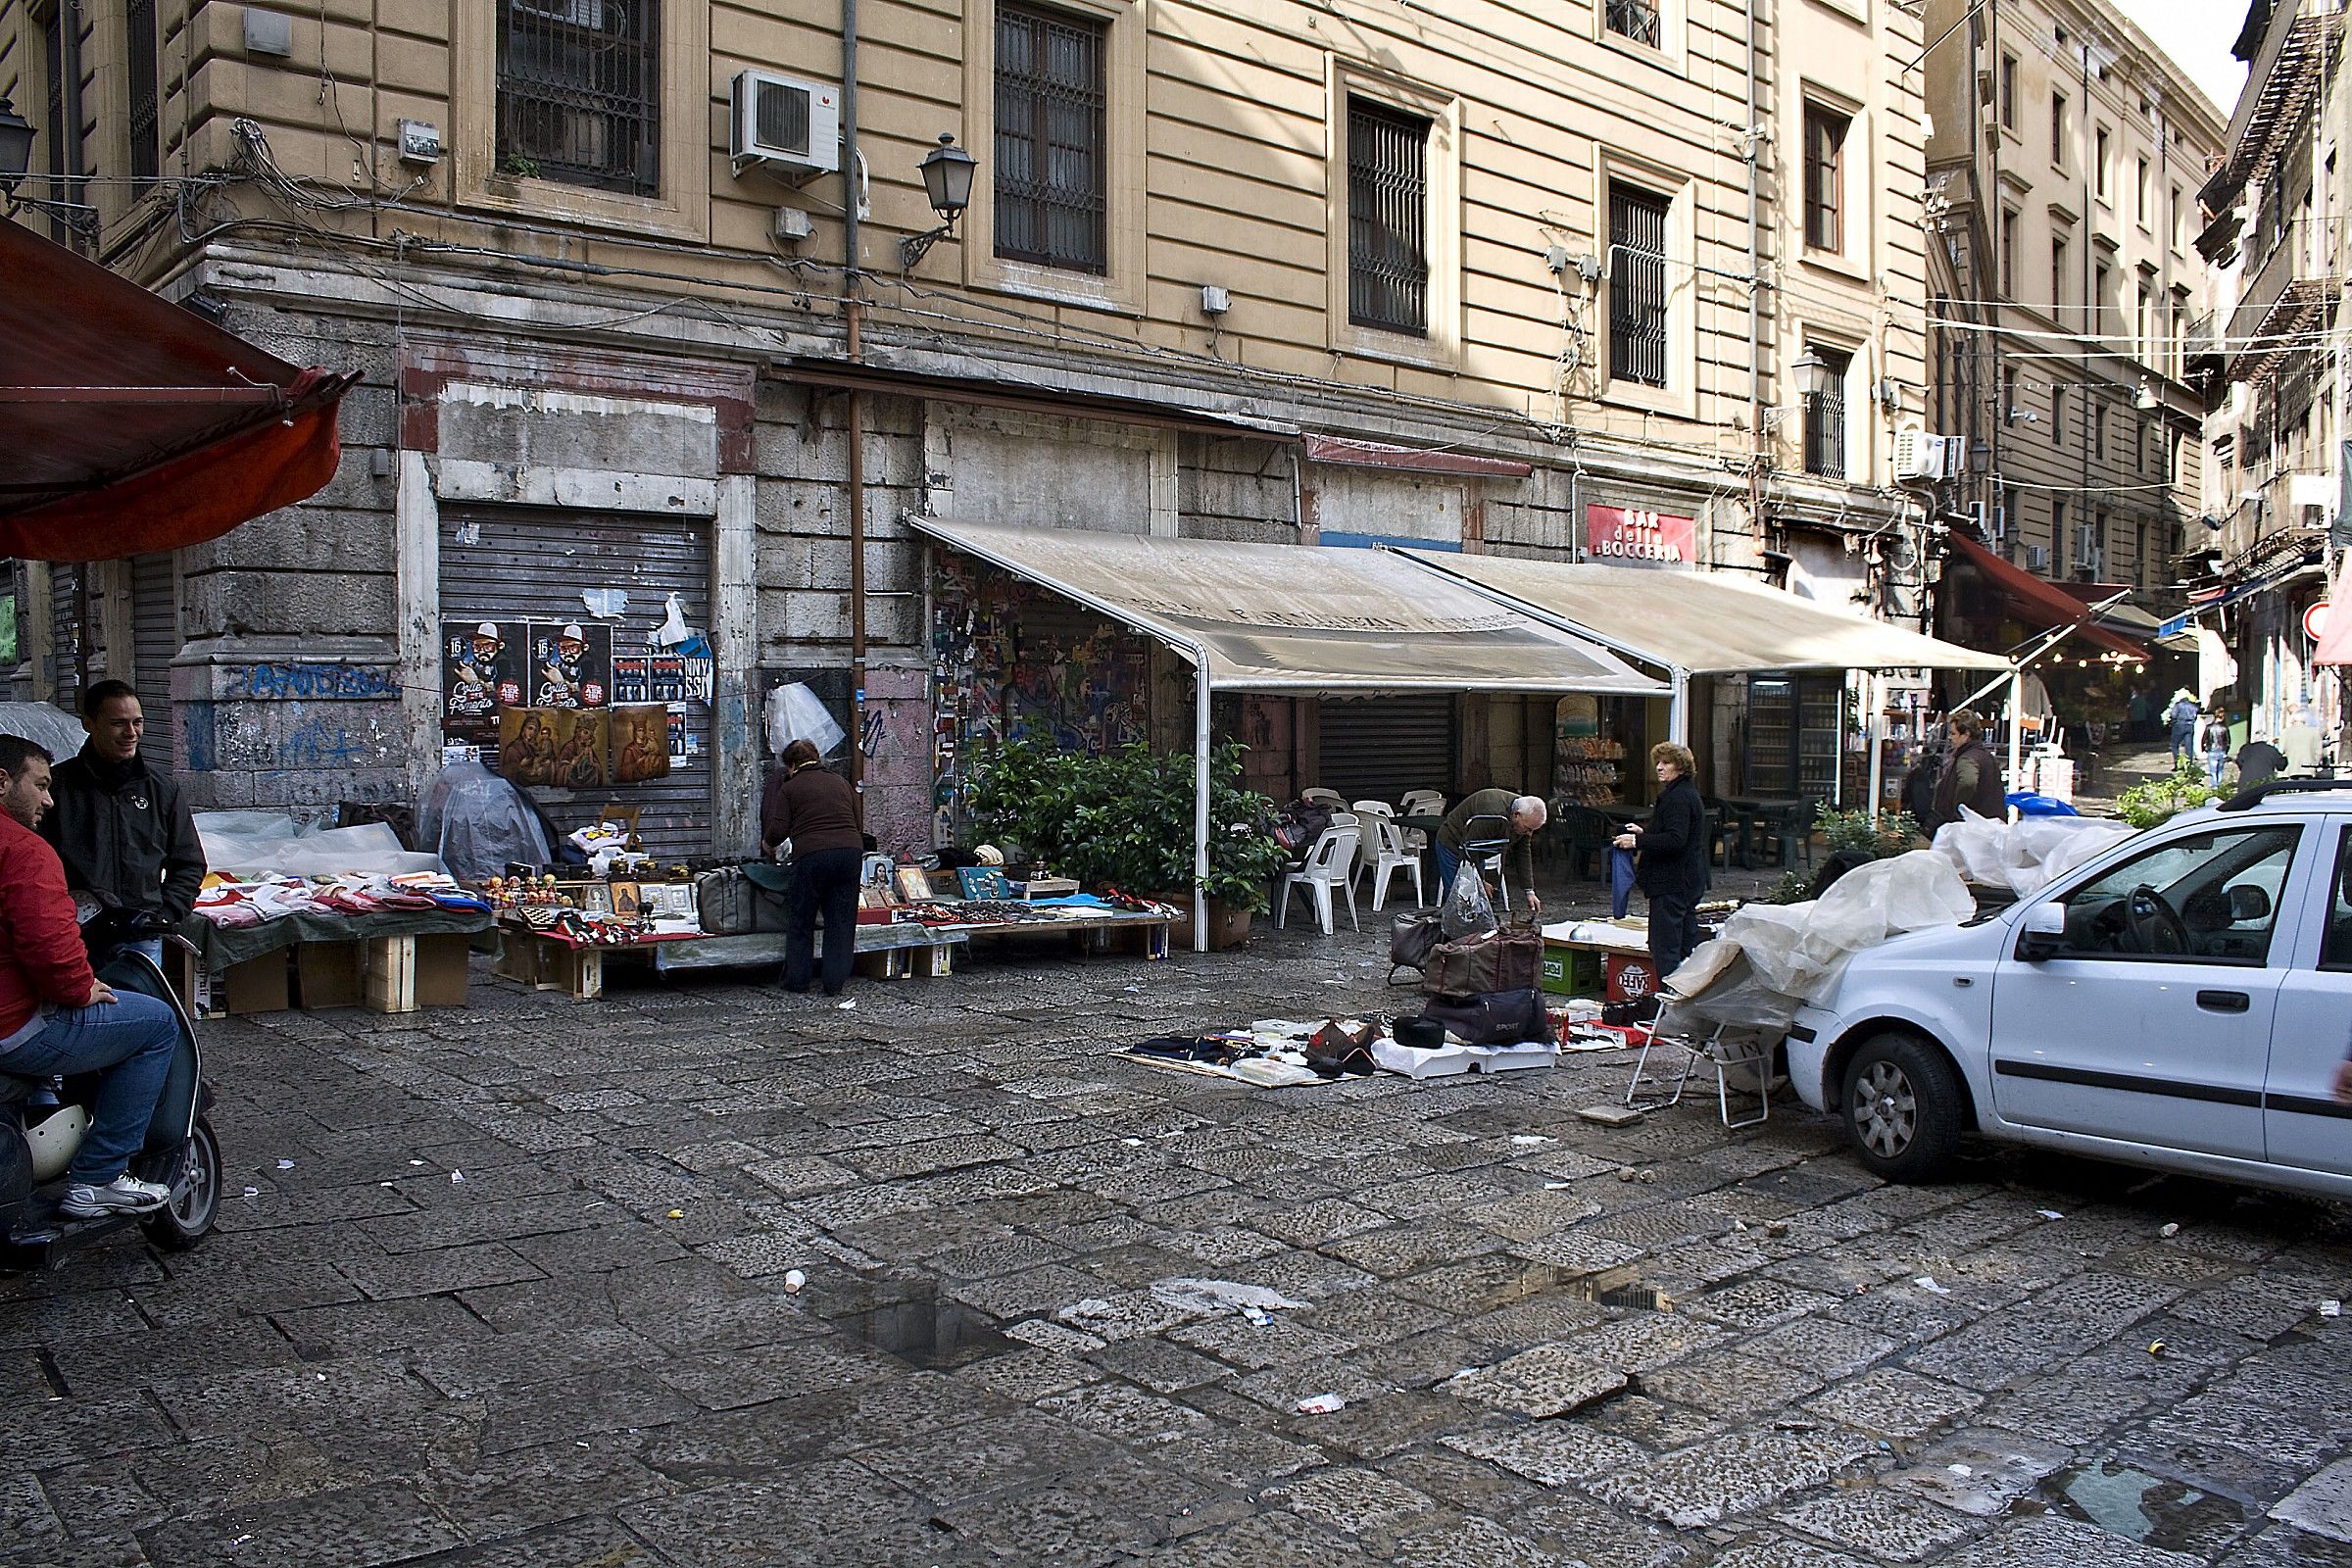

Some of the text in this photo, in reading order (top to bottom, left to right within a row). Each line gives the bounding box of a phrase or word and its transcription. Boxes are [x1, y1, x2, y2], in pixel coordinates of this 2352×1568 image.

[1624, 509, 1659, 529] BAR
[1614, 524, 1663, 545] della
[1600, 539, 1683, 562] BOCCERIA
[450, 640, 462, 653] 16
[537, 642, 548, 655] 16
[1617, 973, 1650, 991] RAFFO
